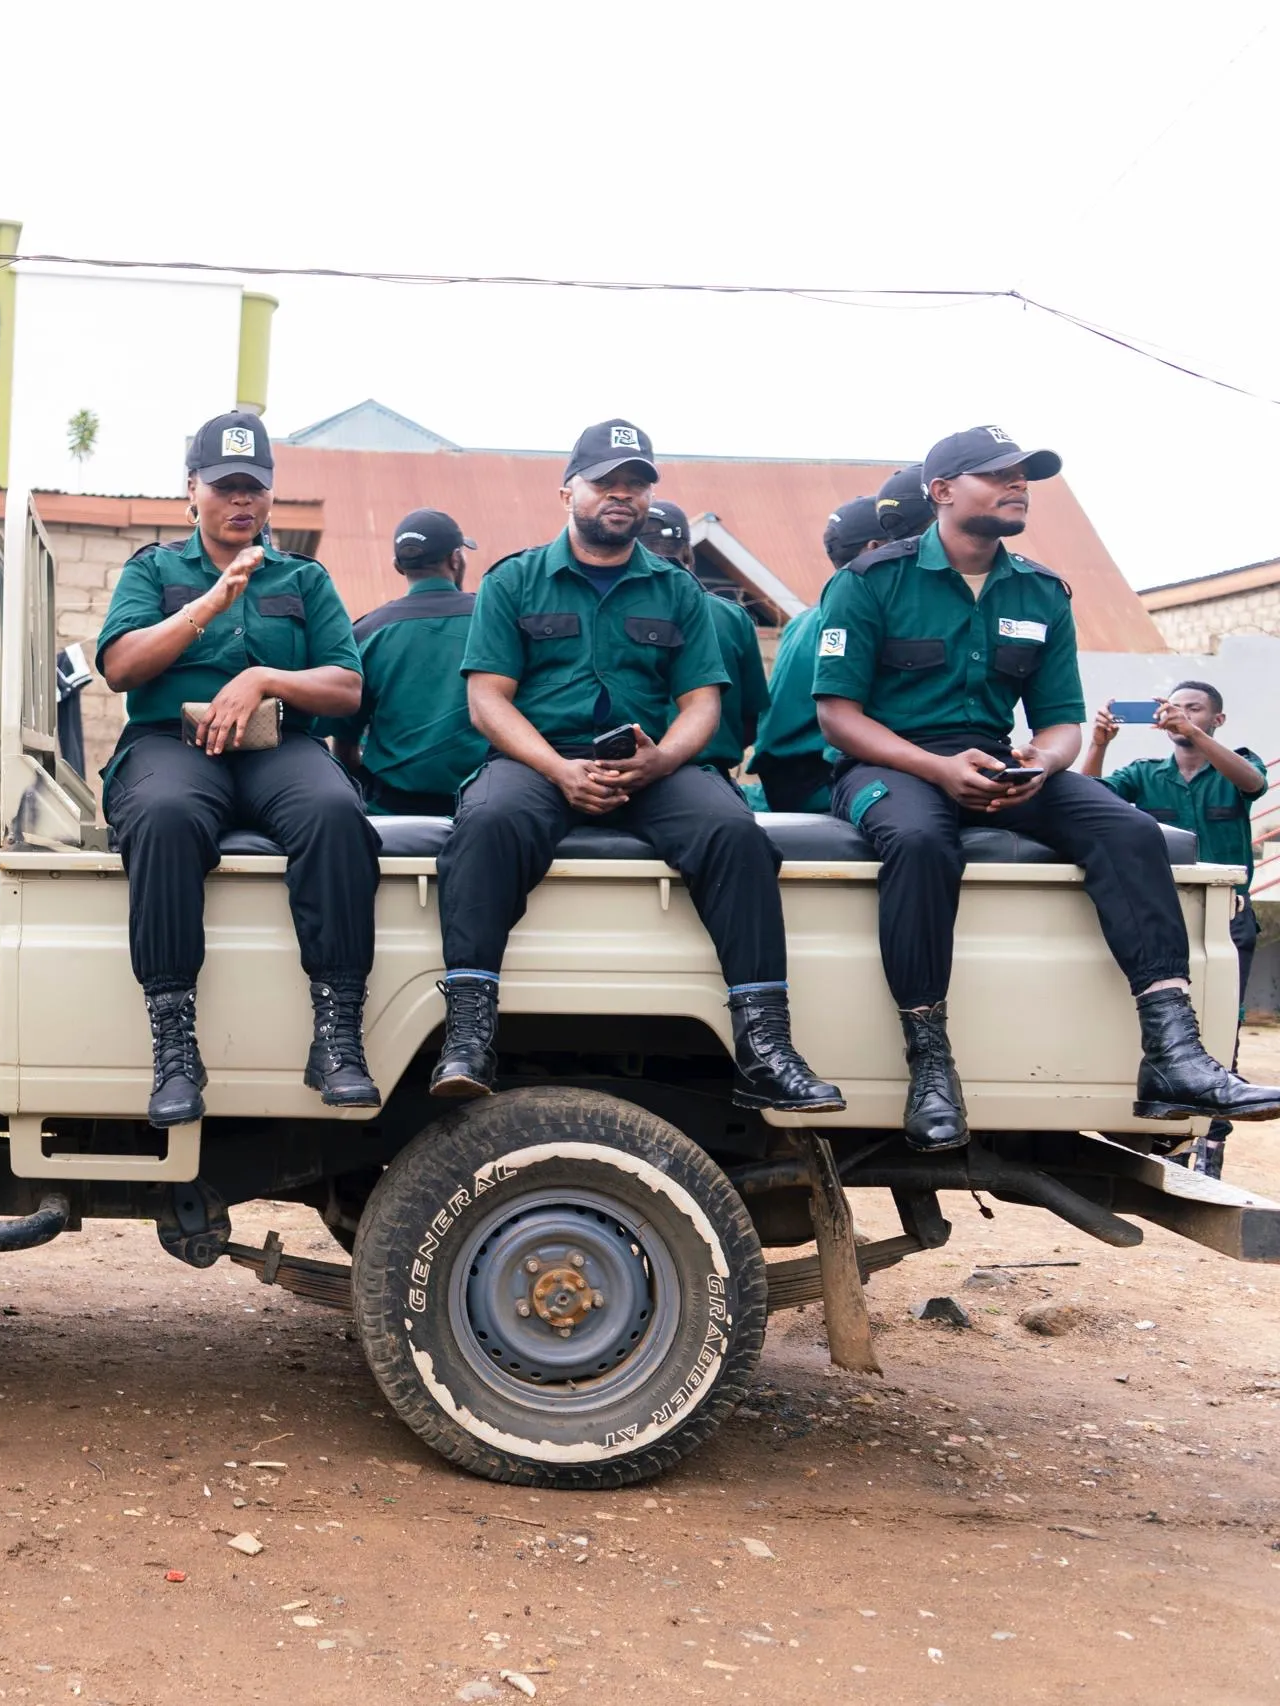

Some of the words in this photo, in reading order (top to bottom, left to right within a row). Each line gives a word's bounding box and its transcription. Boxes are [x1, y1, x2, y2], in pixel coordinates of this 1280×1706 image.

[408, 1160, 517, 1313] GENERAL
[650, 1273, 727, 1427] GRABBER
[601, 1422, 639, 1450] AT
